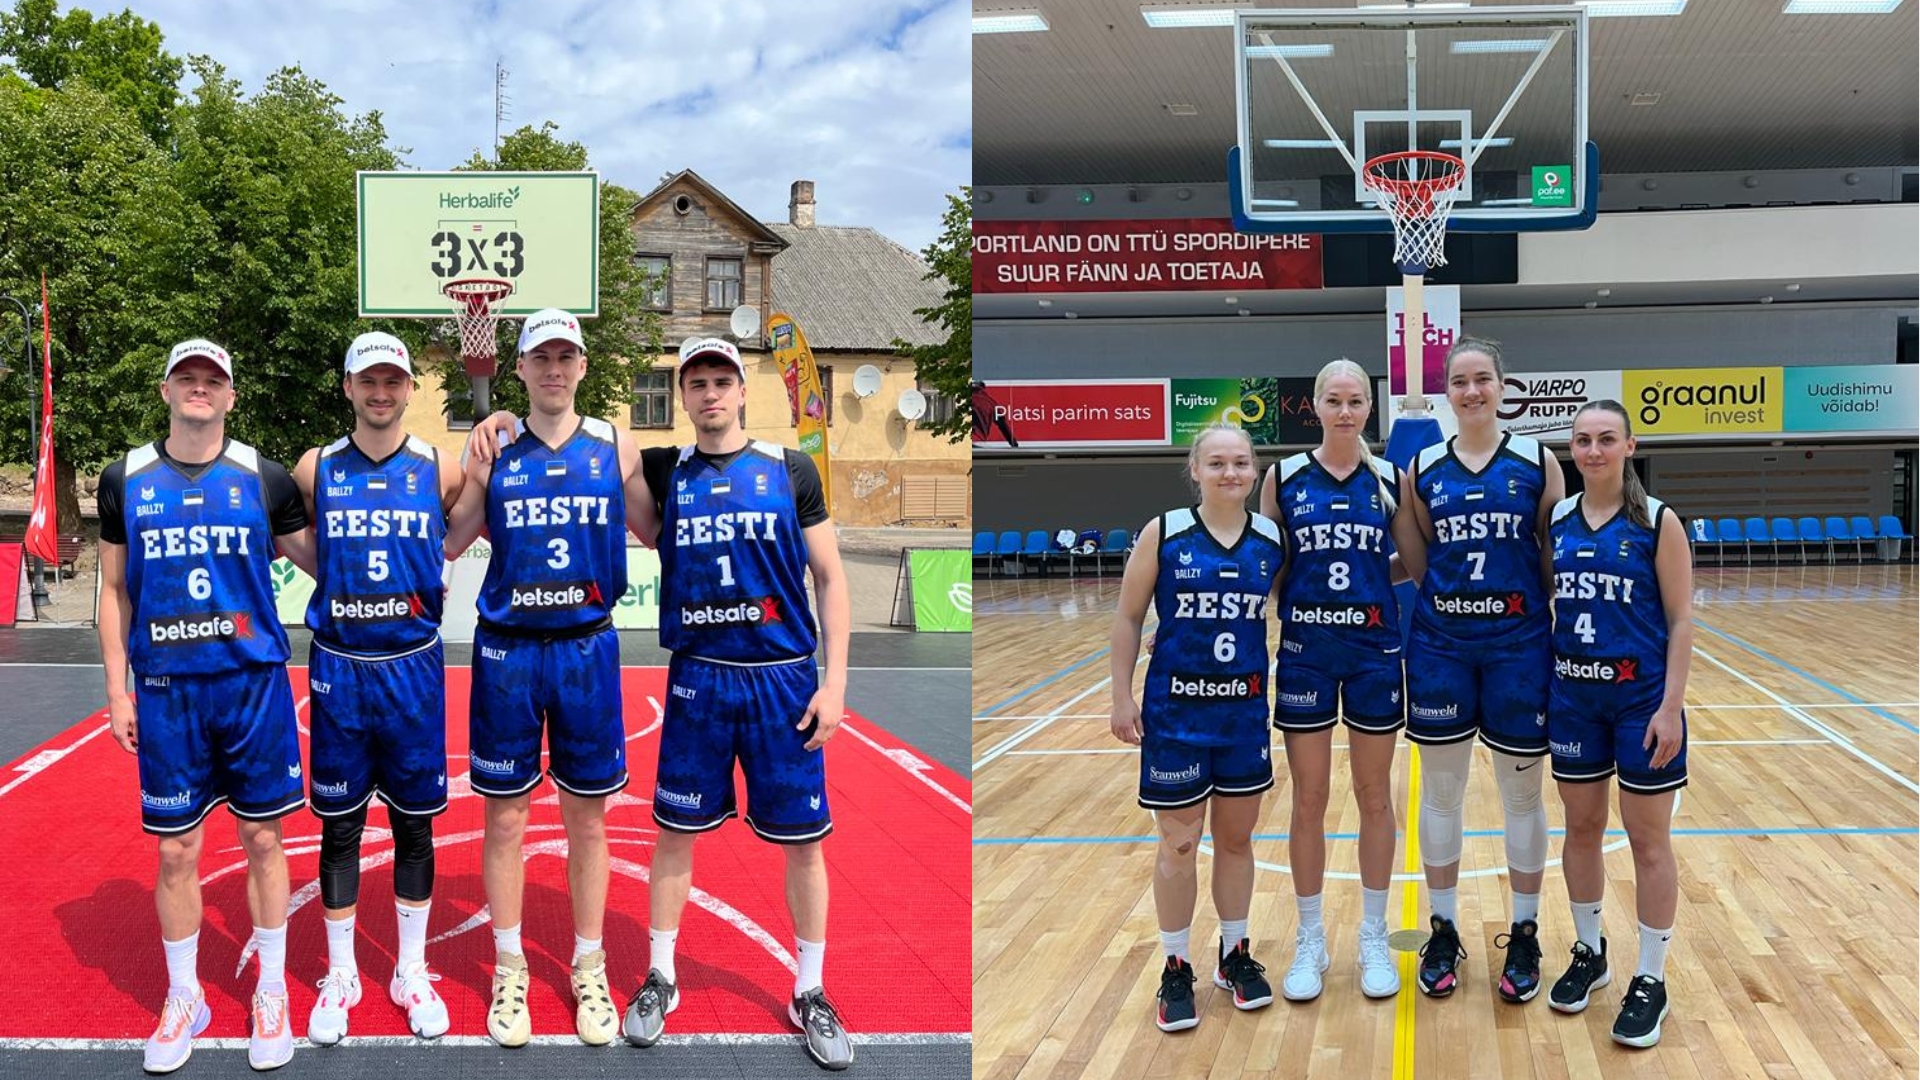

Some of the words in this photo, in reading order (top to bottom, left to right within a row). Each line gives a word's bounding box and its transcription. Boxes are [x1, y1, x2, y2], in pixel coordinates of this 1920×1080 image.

[439, 192, 513, 208] Herbalife
[1087, 234, 1119, 252] ON
[1126, 229, 1167, 252] TTÜ
[1173, 232, 1311, 251] SPORDIPERE
[998, 264, 1060, 283] SUUR
[1066, 260, 1127, 282] FÄNN
[1134, 262, 1162, 281] JA
[1167, 261, 1264, 280] TOETAJA
[528, 316, 569, 334] betsafe
[1395, 328, 1453, 345] TCH
[175, 345, 216, 357] betsafe
[357, 344, 397, 356] betsafe
[1529, 378, 1586, 396] VARPO
[1808, 383, 1892, 397] Uudishimu
[1175, 394, 1217, 409] Fujitsu
[1640, 376, 1766, 425] graanul
[1821, 399, 1880, 413] võidab!
[994, 405, 1045, 421] Platsi
[1052, 404, 1109, 424] parim
[1114, 405, 1151, 420] sats
[1704, 408, 1765, 424] invest
[503, 474, 529, 487] BALLZY
[327, 486, 354, 497] BALLZY
[136, 503, 165, 517] BALLZY
[504, 496, 609, 528] EESTI
[325, 510, 430, 539] EESTI
[676, 512, 778, 547] EESTI
[1435, 512, 1522, 544] EESTI
[140, 526, 250, 559] EESTI
[1295, 523, 1384, 553] EESTI
[547, 538, 570, 569] 3
[367, 551, 390, 582] 5
[716, 555, 735, 587] 1
[1174, 568, 1201, 579] BALLZY
[1328, 561, 1350, 591] 8
[1467, 552, 1486, 581] 7
[188, 568, 212, 600] 6
[511, 586, 585, 606] betsafe
[1434, 595, 1505, 614] betsafe
[331, 598, 409, 618] betsafe
[682, 603, 761, 625] betsafe
[1292, 606, 1365, 625] betsafe
[151, 619, 234, 642] betsafe
[1574, 613, 1596, 643] 4
[481, 645, 507, 661] BALLZY
[1213, 632, 1236, 662] 6
[1171, 677, 1248, 697] betsafe
[1150, 763, 1201, 784] Scanweld
